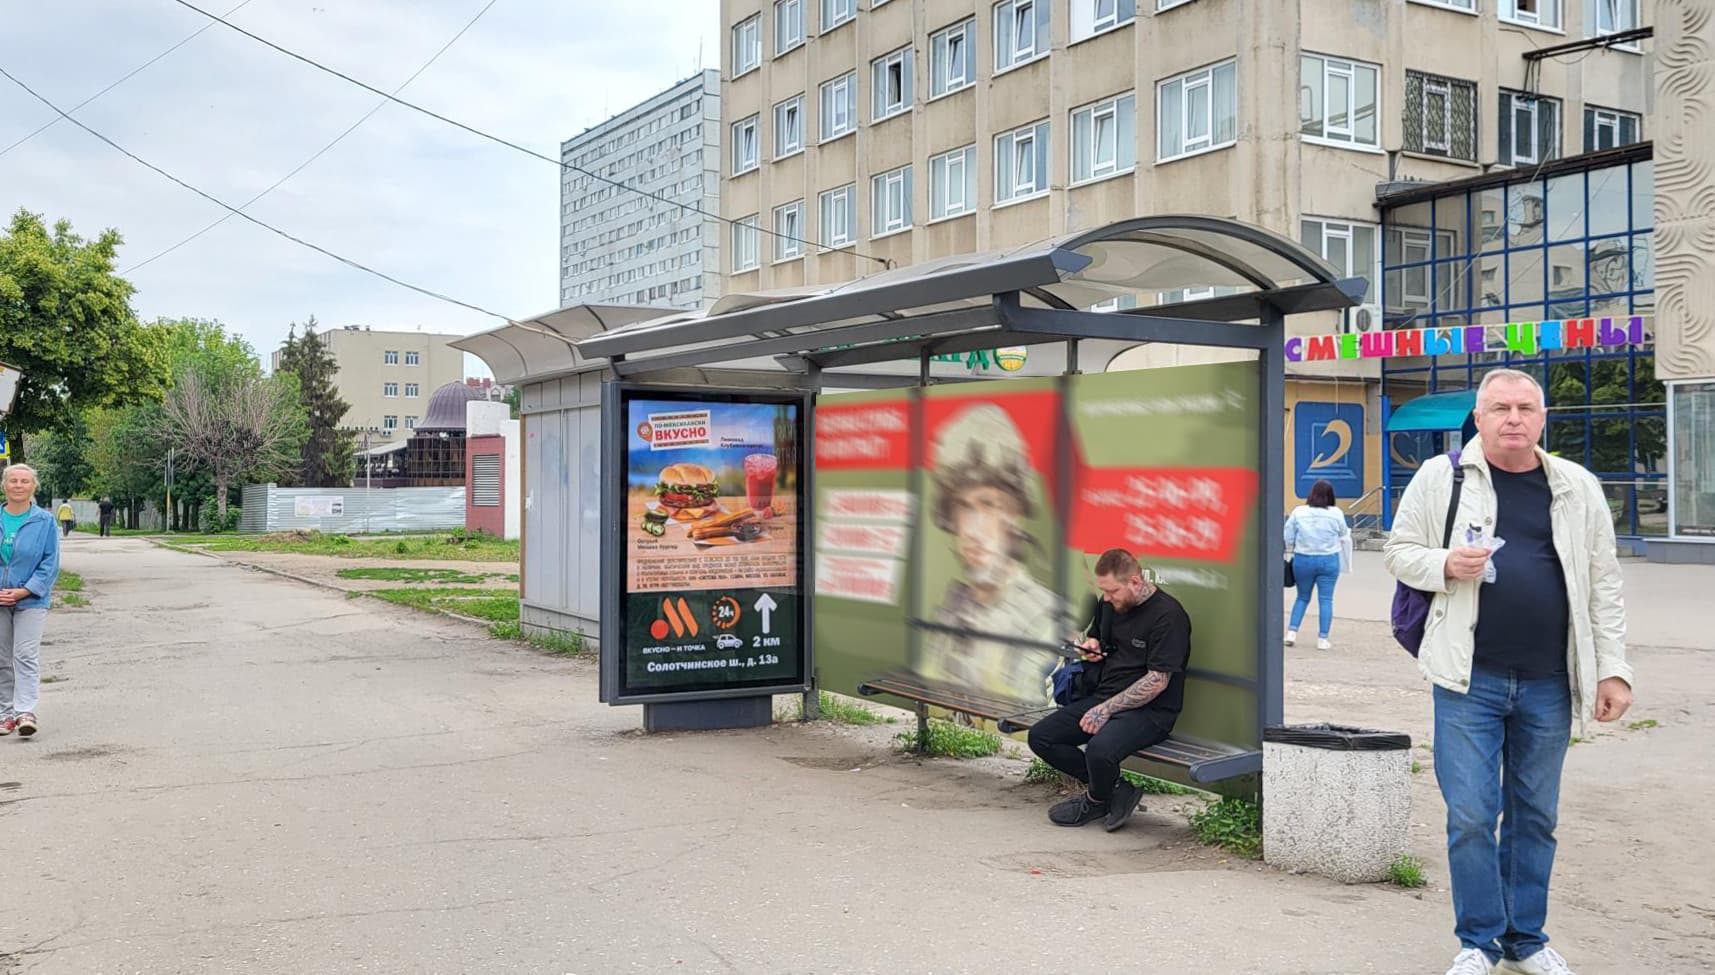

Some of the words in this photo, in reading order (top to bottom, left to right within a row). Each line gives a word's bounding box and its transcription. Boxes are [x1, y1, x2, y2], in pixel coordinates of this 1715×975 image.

[1284, 326, 1486, 362] СМЕШНЫЕ
[1506, 316, 1643, 355] ЦЕНЫ
[655, 427, 706, 441] ВКУСНО
[752, 635, 761, 648] 2
[642, 646, 670, 654] ВКУСНО
[683, 644, 706, 652] ТОЧКА
[647, 658, 727, 672] Солотчинское
[746, 656, 757, 667] д.
[758, 654, 779, 665] 13а
